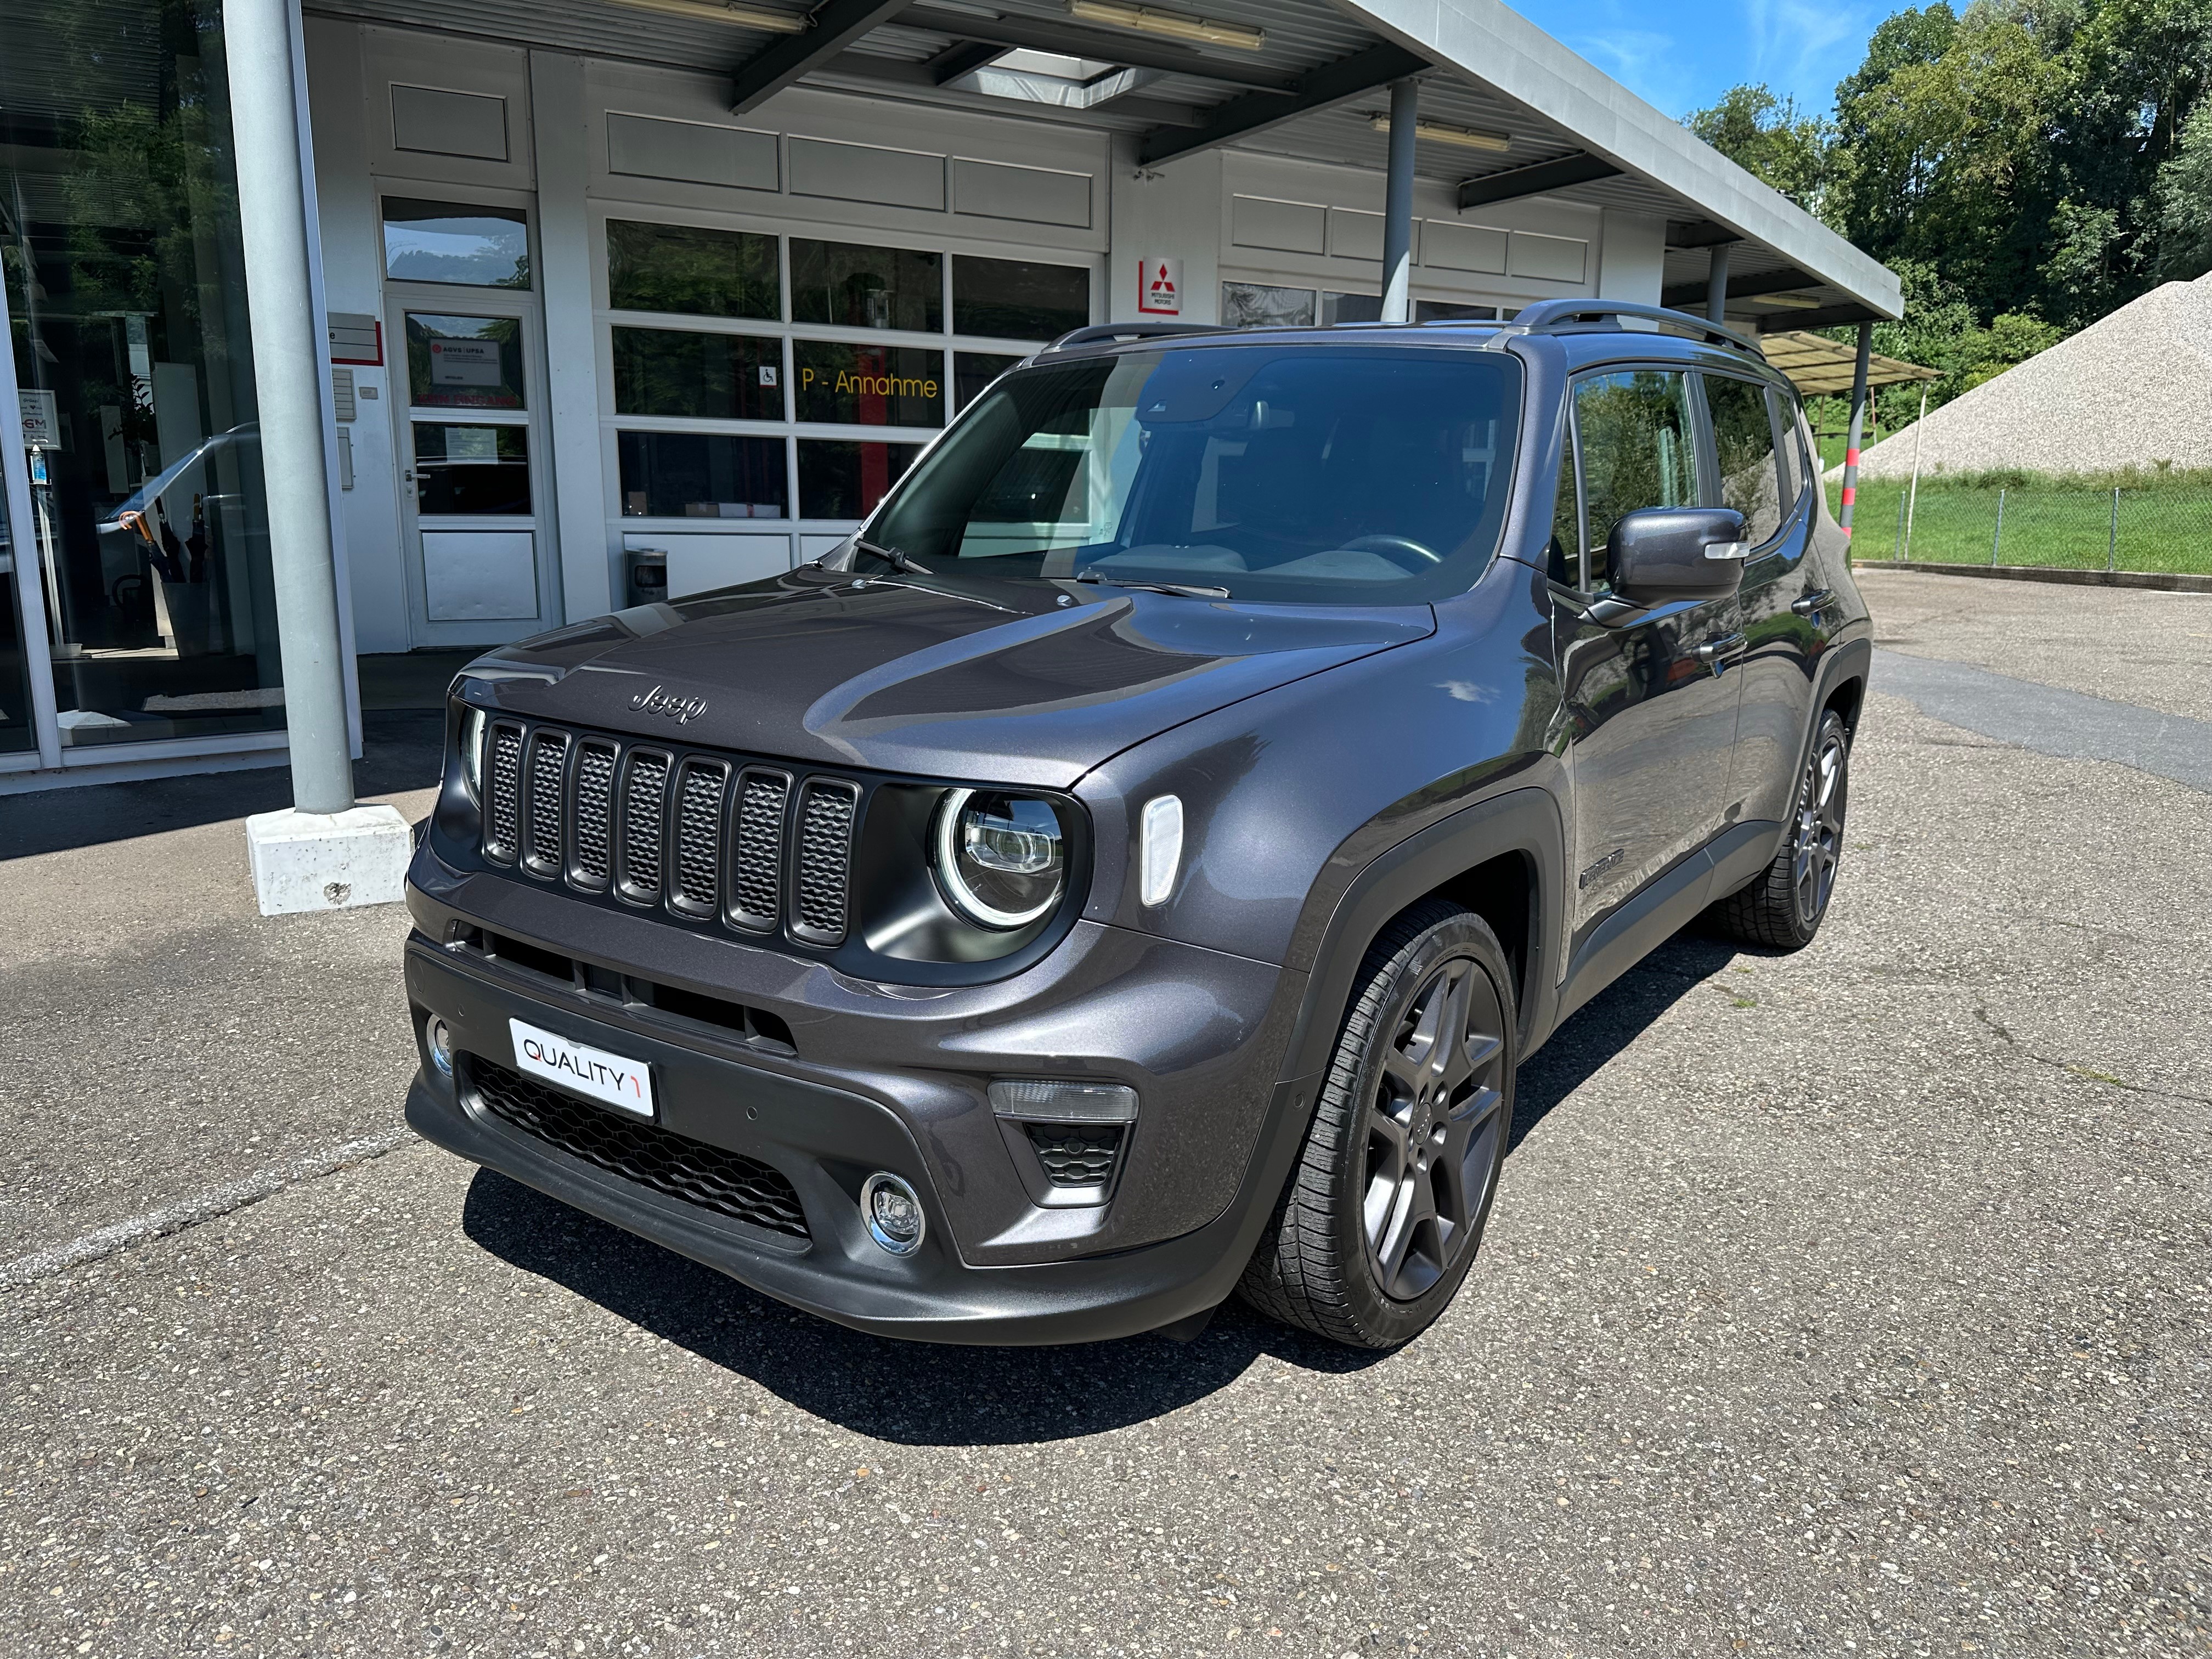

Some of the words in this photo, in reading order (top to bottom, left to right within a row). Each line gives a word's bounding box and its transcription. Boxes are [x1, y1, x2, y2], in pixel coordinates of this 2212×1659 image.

[802, 368, 814, 391] P
[835, 370, 938, 398] Annahme
[627, 685, 708, 725] Jeep
[524, 1039, 625, 1091] QUALITY
